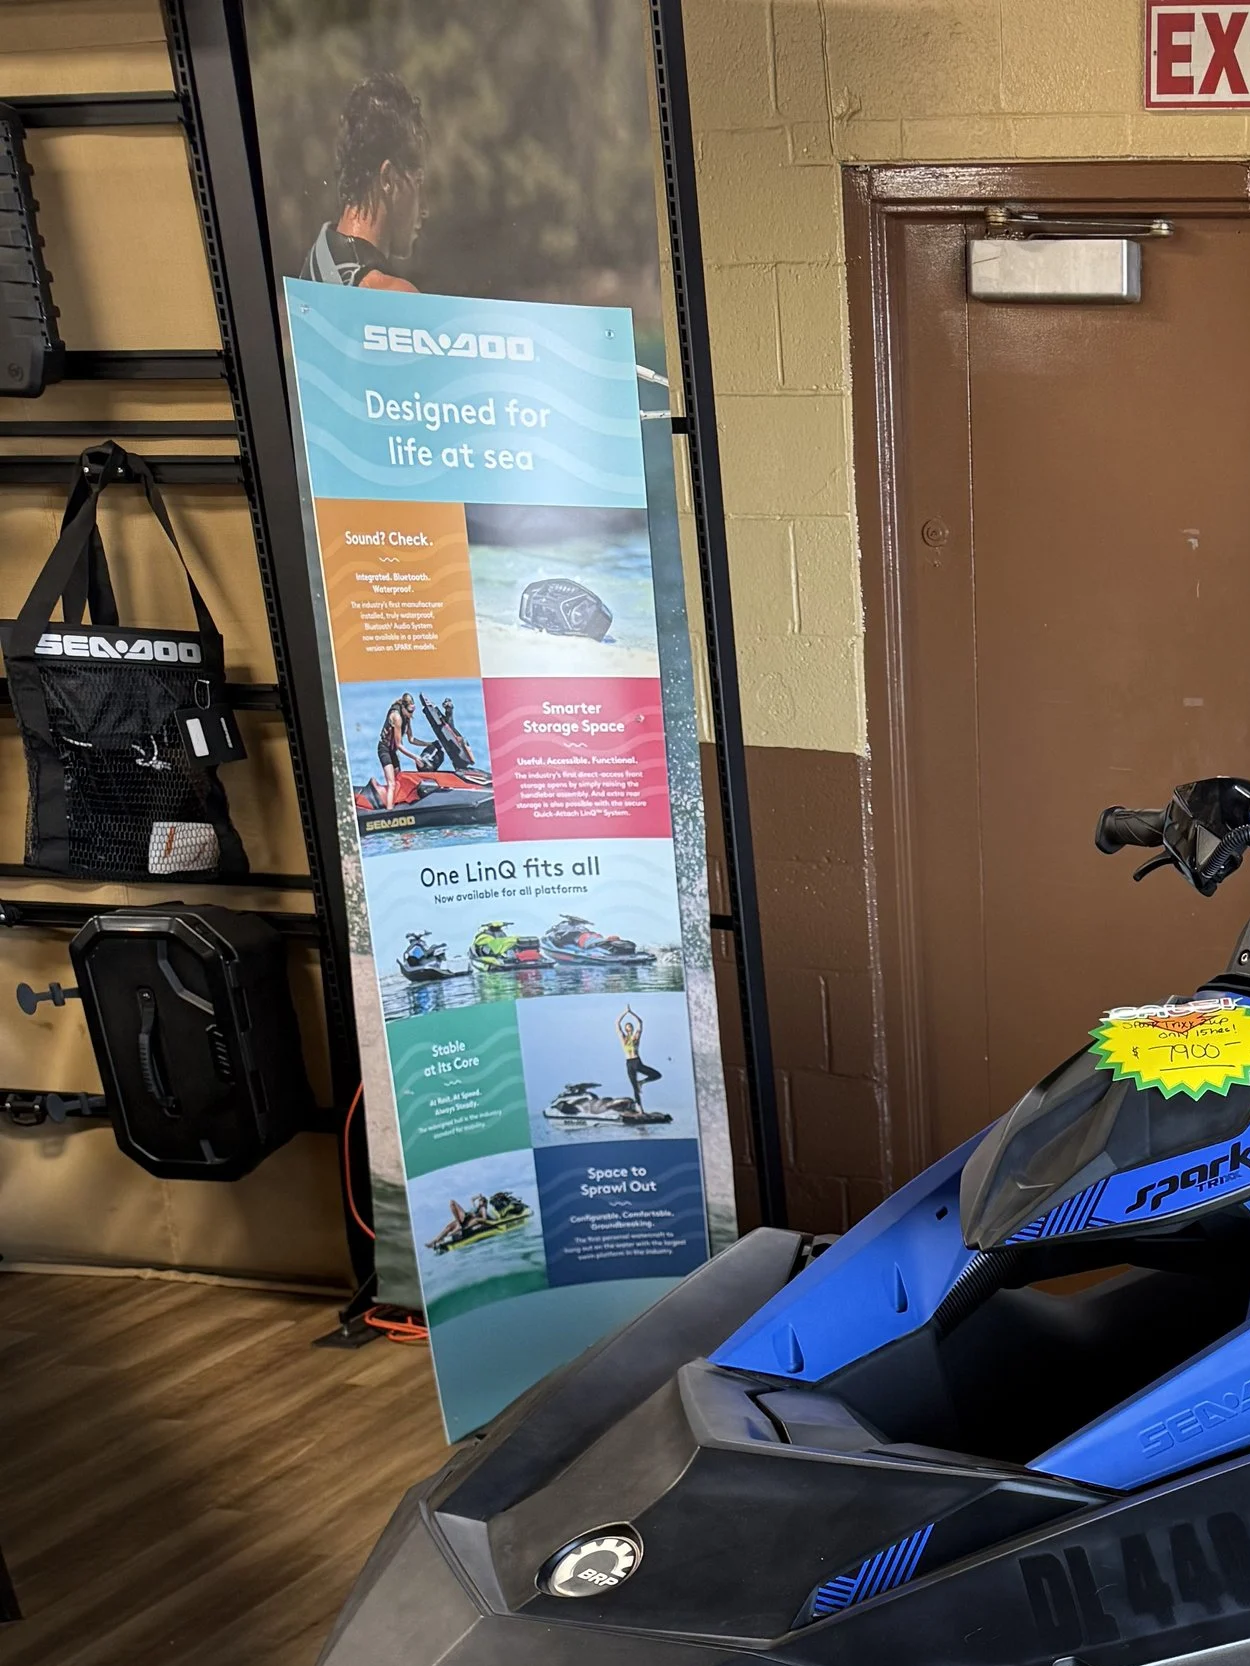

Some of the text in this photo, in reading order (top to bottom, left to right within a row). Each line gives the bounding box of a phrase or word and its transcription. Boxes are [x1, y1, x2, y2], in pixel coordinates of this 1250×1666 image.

[365, 390, 550, 431] Designed for
[388, 436, 534, 470] life at sea
[345, 531, 434, 546] Sound? Check.
[393, 573, 431, 581] Bluetooth.
[372, 585, 414, 595] Waterproof.
[542, 702, 602, 714] Smarter
[523, 720, 625, 736] Storage Space
[517, 756, 638, 766] Useful. Accessible. Functional.
[420, 856, 600, 887] One LinQ fits all
[434, 884, 588, 904] Now available for all platforms
[432, 1040, 466, 1057] Stable
[424, 1057, 480, 1077] at Its Core
[587, 1166, 647, 1182] Space to
[580, 1181, 657, 1198] Sprawl Out
[577, 1568, 619, 1587] BRP
[1019, 1544, 1121, 1650] DL
